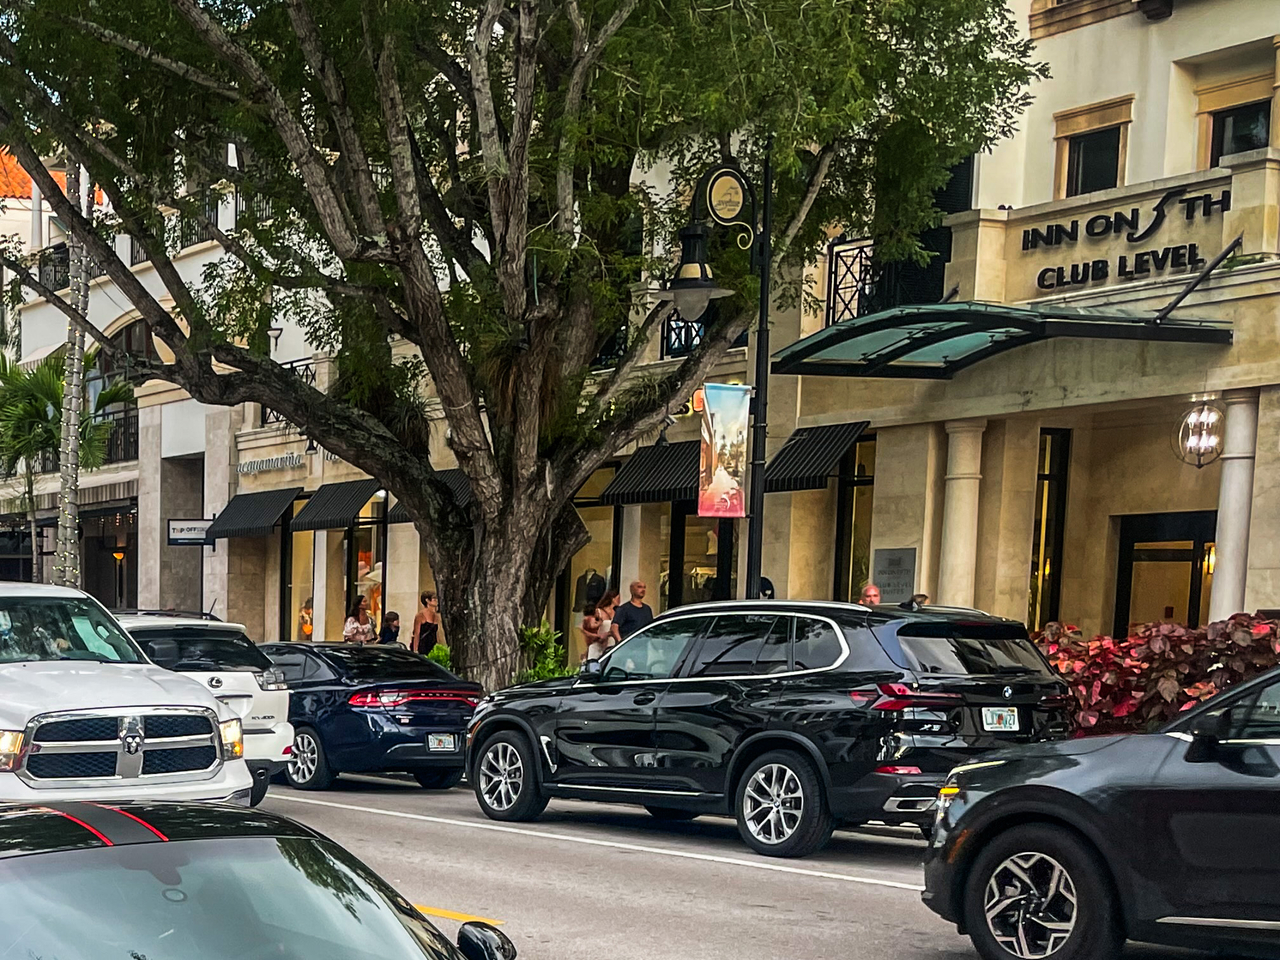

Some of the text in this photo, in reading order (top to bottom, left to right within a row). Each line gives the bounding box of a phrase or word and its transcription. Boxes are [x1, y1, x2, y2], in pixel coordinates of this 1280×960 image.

[1021, 188, 1232, 251] INN ON 5TH
[1036, 243, 1205, 290] CLUB LEVEL
